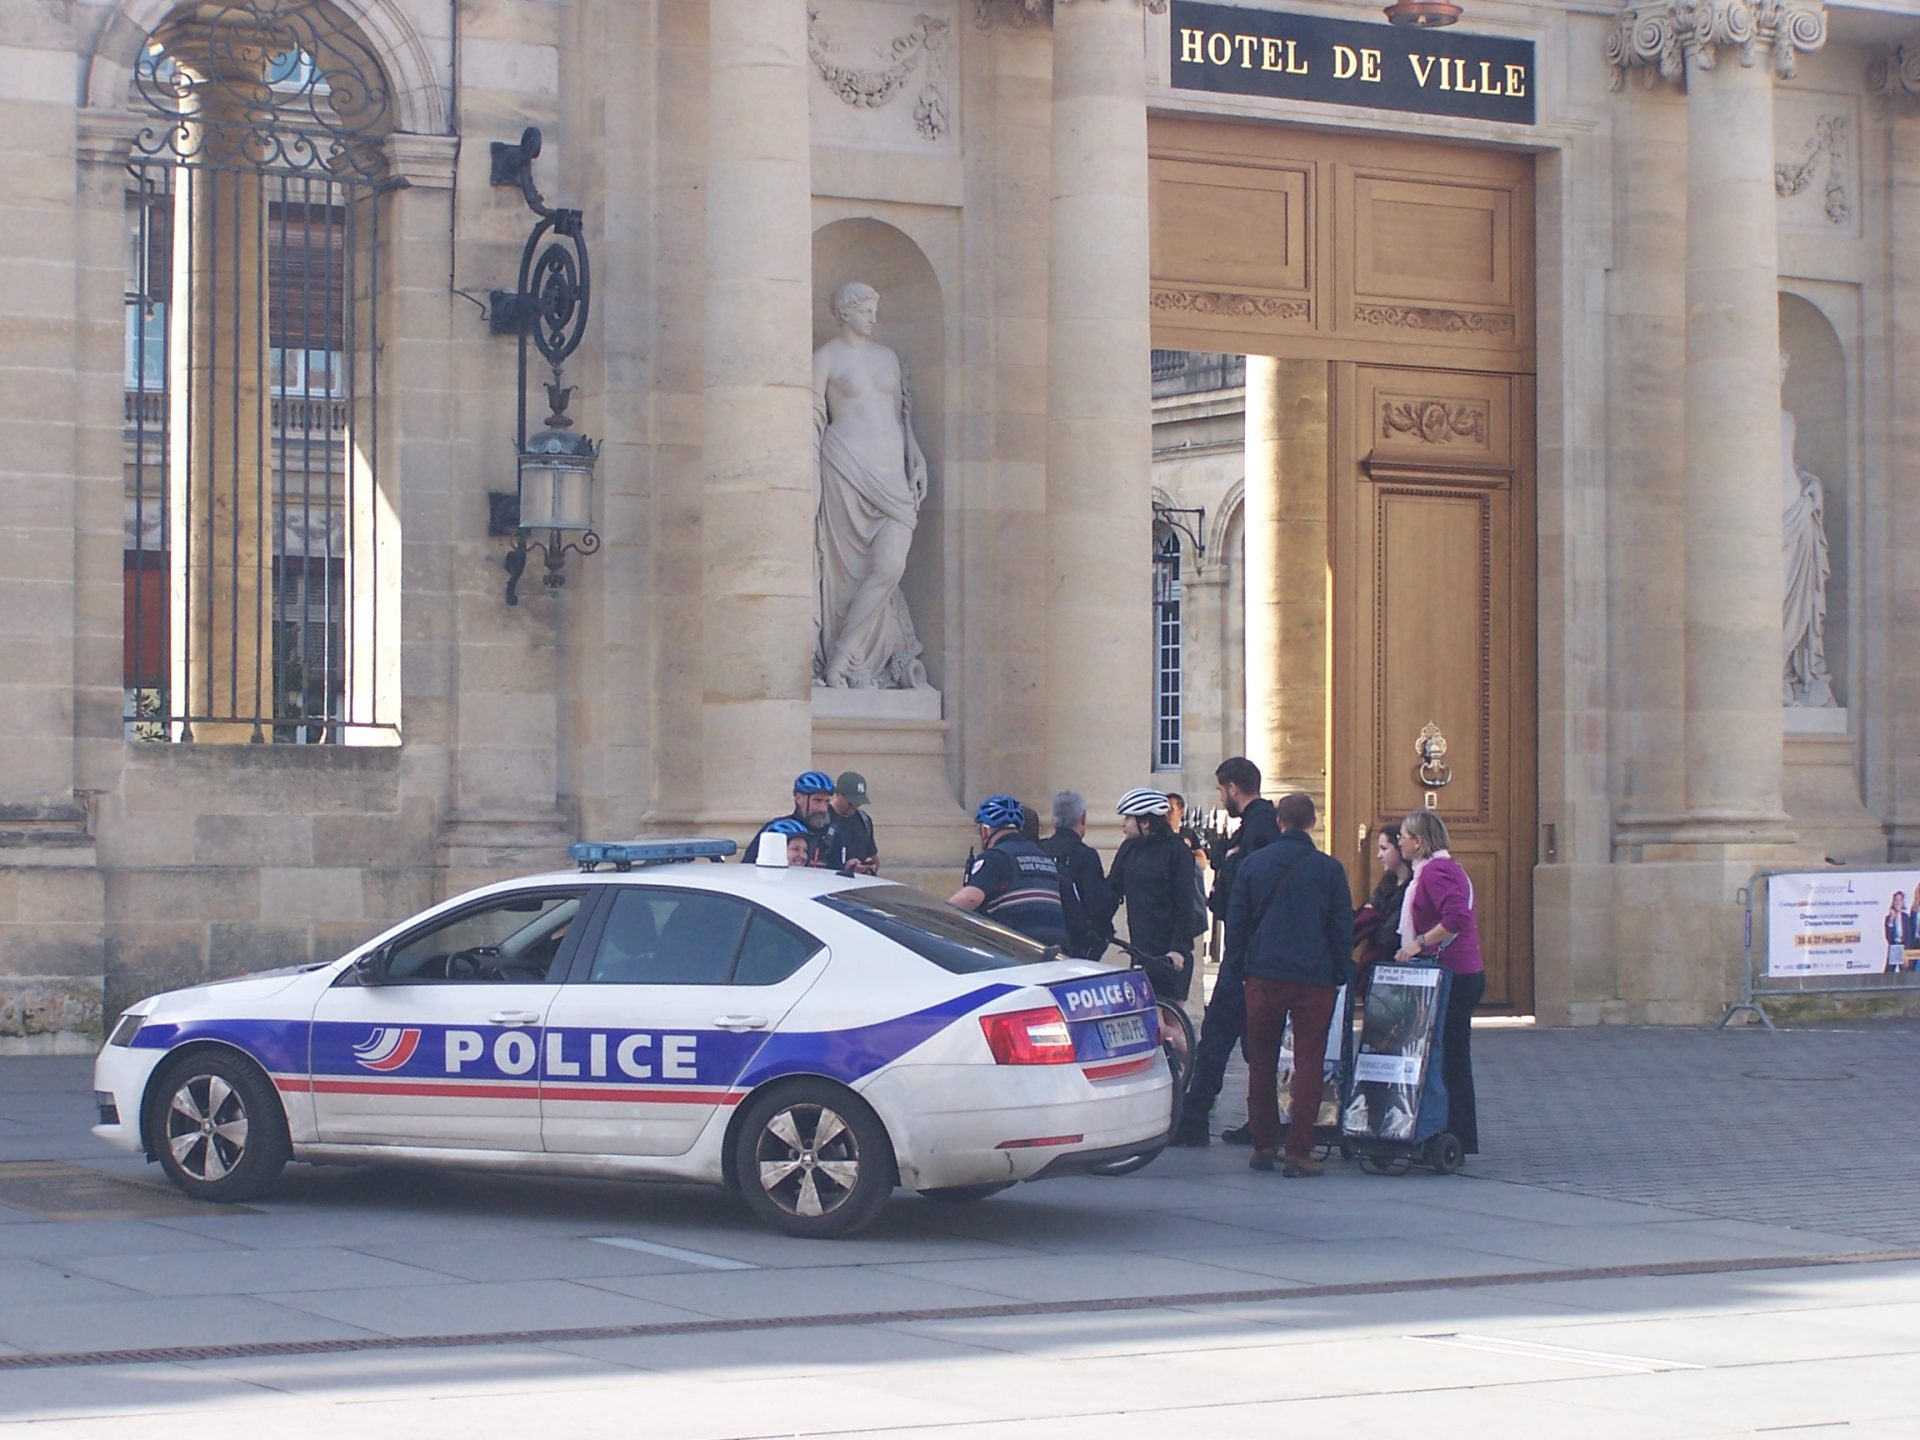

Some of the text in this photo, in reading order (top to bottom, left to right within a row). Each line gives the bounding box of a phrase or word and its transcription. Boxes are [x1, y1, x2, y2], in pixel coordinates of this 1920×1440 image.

[1180, 29, 1525, 97] HOTEL DE VILLE
[1065, 984, 1125, 1012] POLICE
[445, 1030, 698, 1079] POLICE
